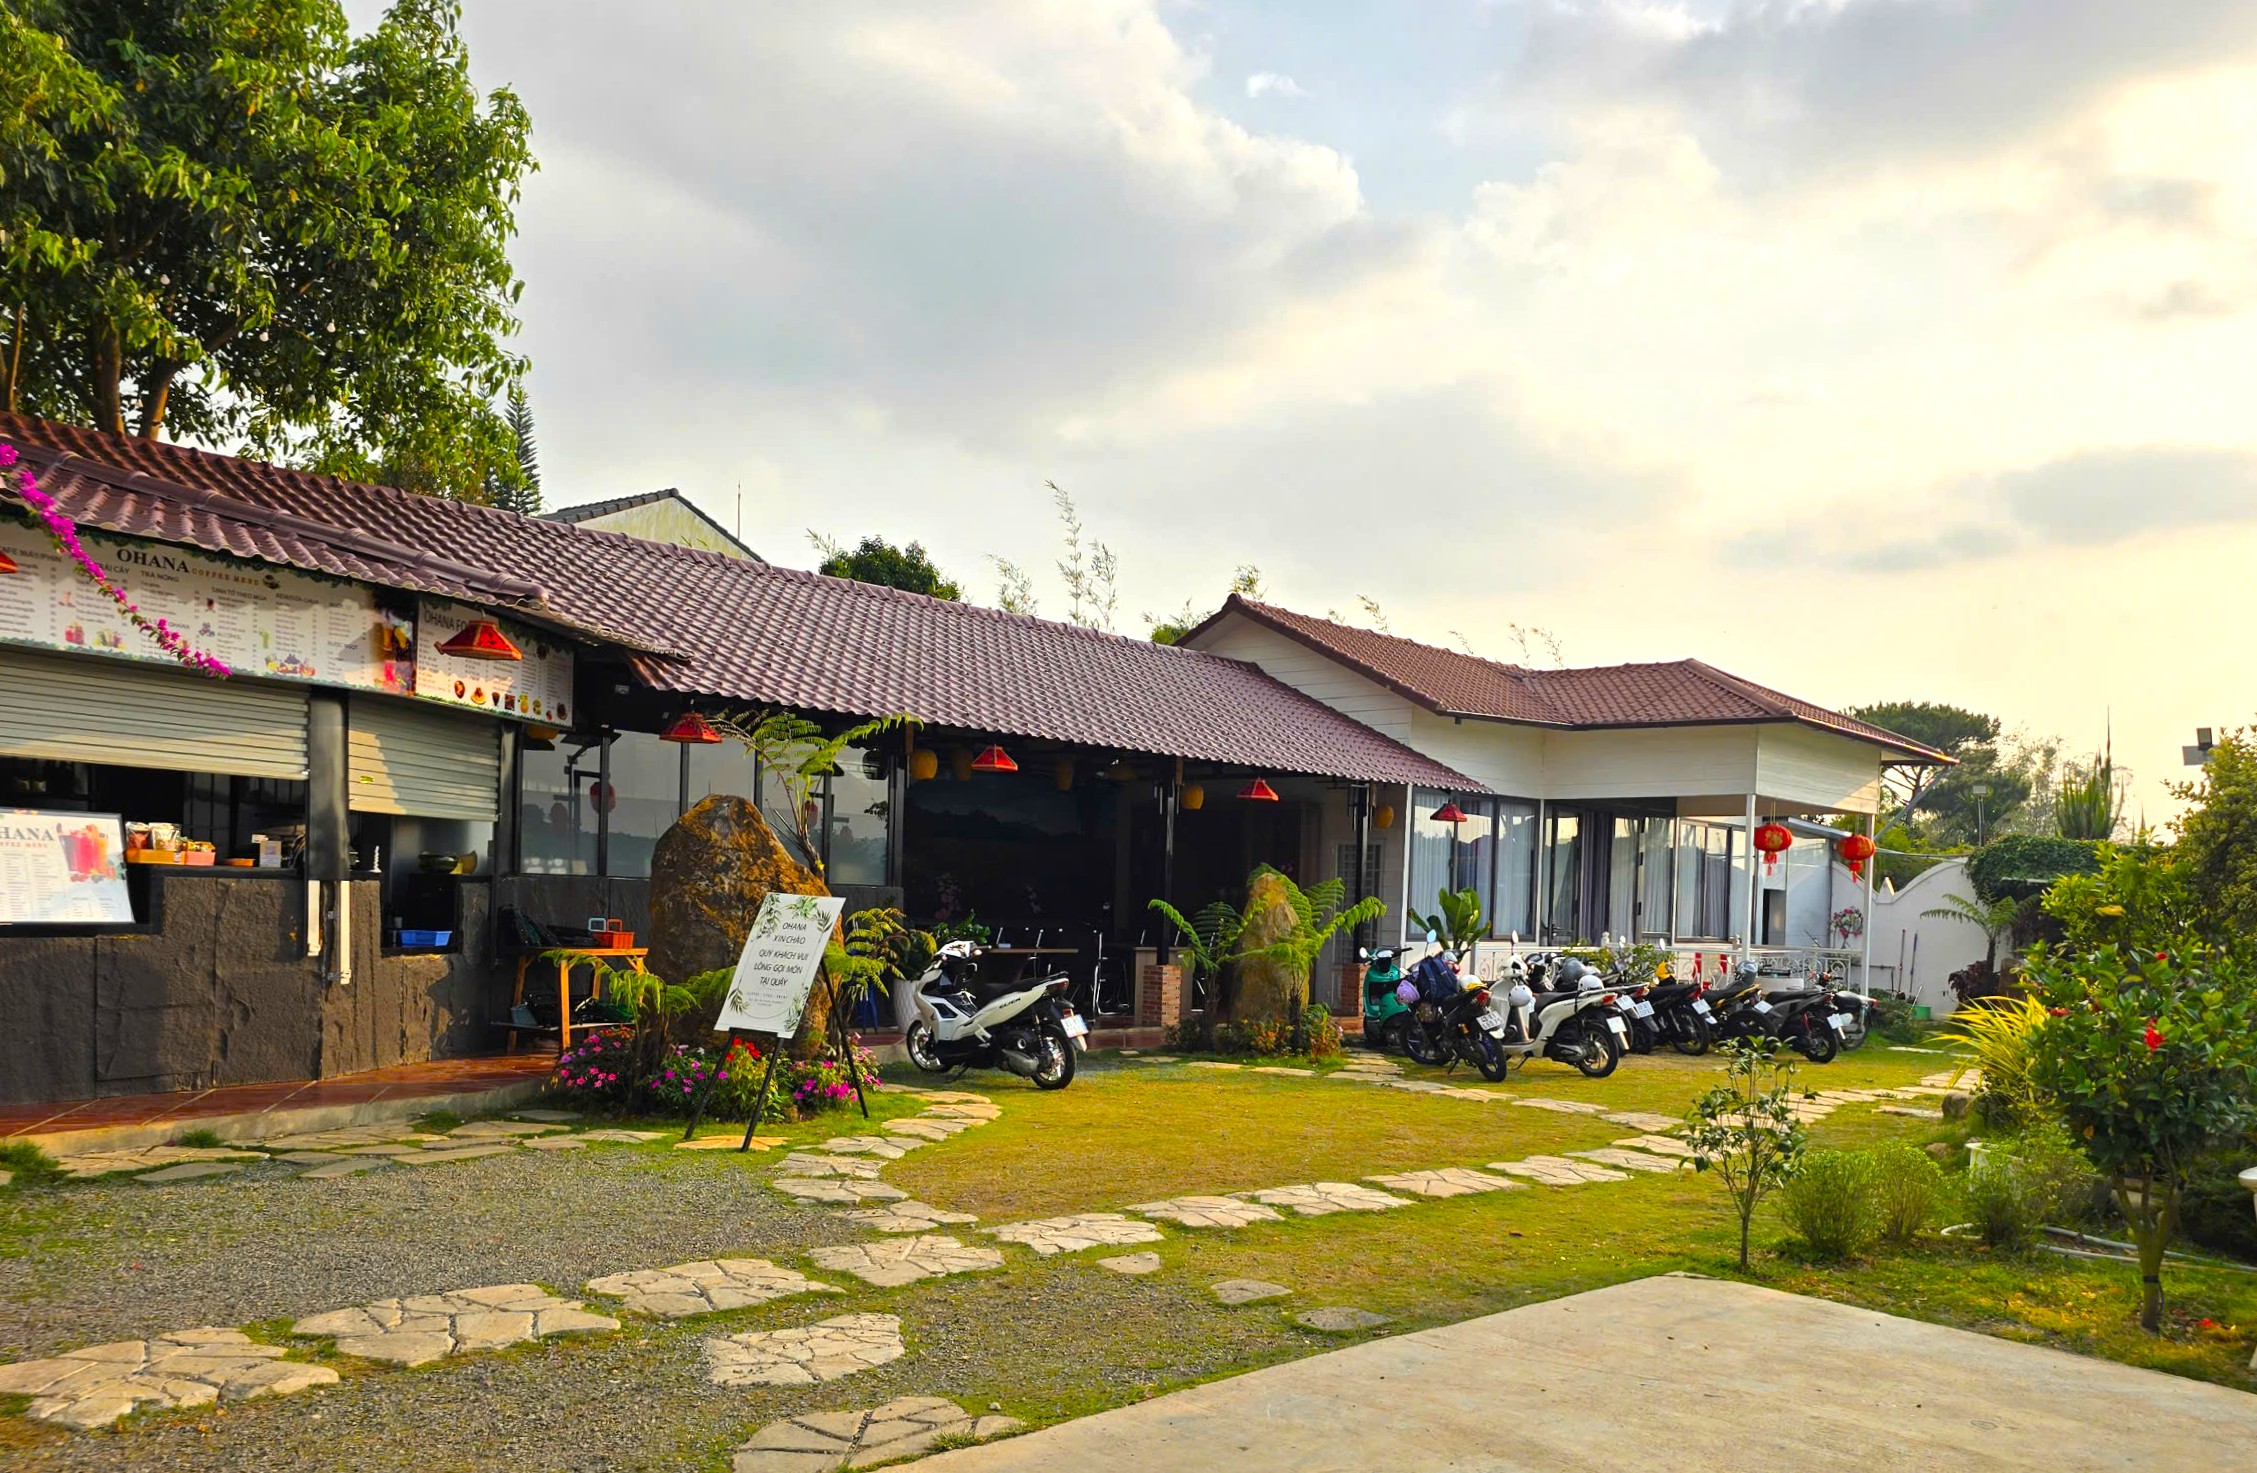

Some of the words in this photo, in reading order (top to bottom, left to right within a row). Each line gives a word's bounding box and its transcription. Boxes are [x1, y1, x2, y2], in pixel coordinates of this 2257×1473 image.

[117, 548, 190, 573] OHANA
[192, 567, 230, 581] COFFEE
[424, 609, 455, 631] OHANA
[0, 826, 54, 841] HANA
[782, 922, 807, 931] OHANA
[773, 935, 786, 943] XIN
[786, 934, 805, 944] CHÀO
